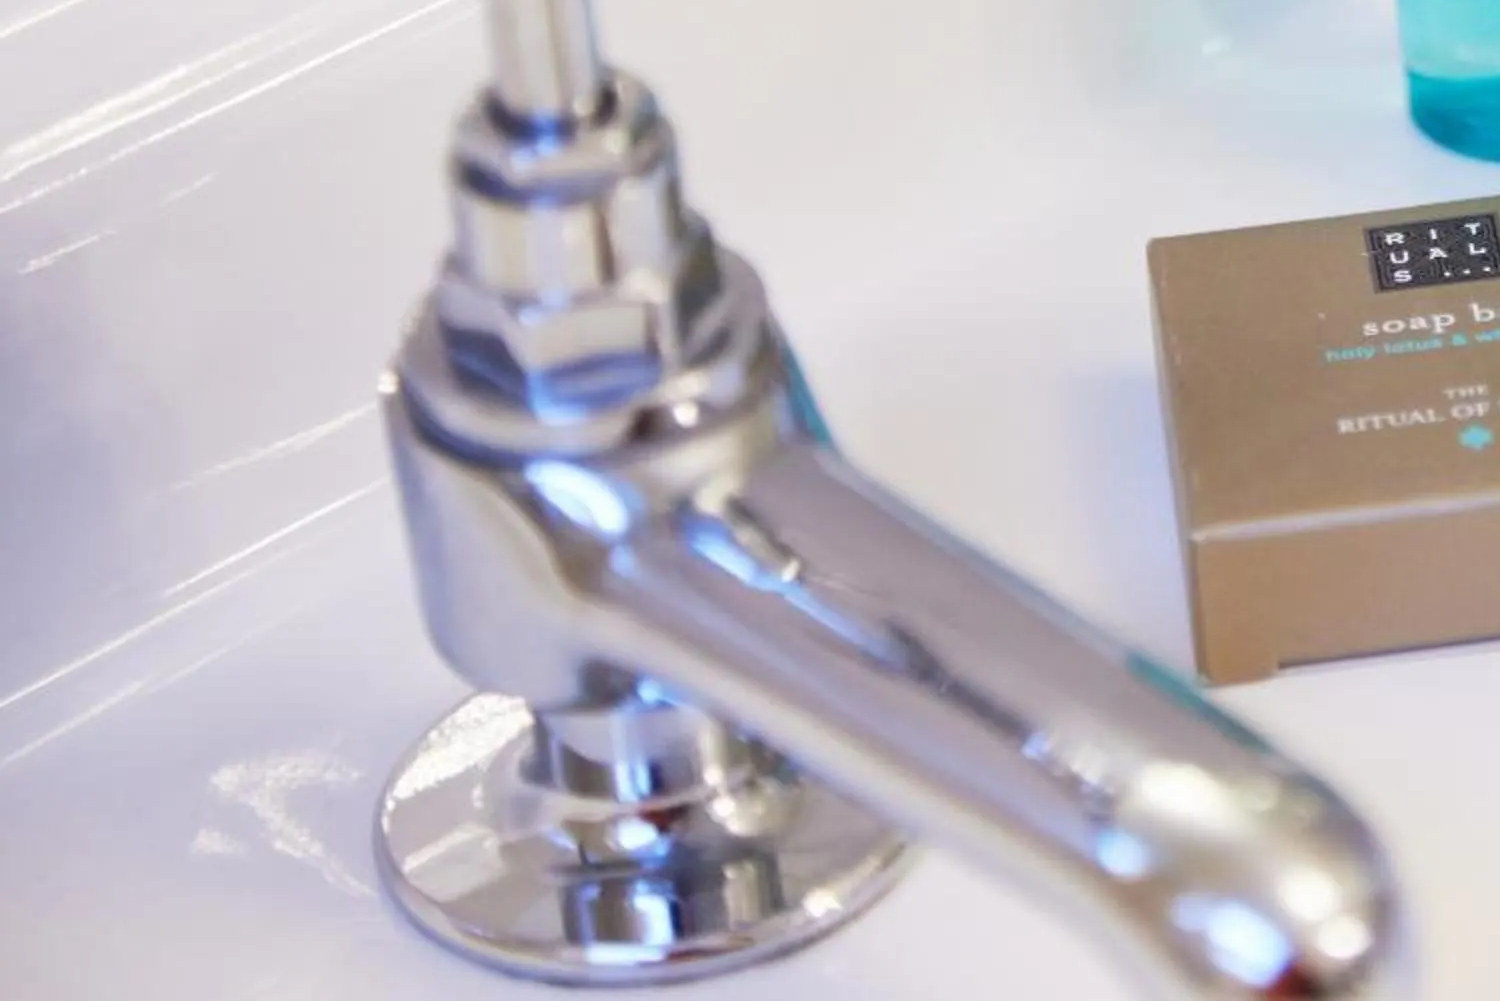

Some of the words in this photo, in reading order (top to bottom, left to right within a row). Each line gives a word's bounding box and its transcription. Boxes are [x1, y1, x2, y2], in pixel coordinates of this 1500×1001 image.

[1362, 312, 1456, 336] soap
[1325, 346, 1376, 363] holy
[1383, 337, 1443, 355] lotus
[1443, 384, 1489, 400] THE
[1337, 407, 1445, 435] RITUAL
[1450, 402, 1491, 421] OF
